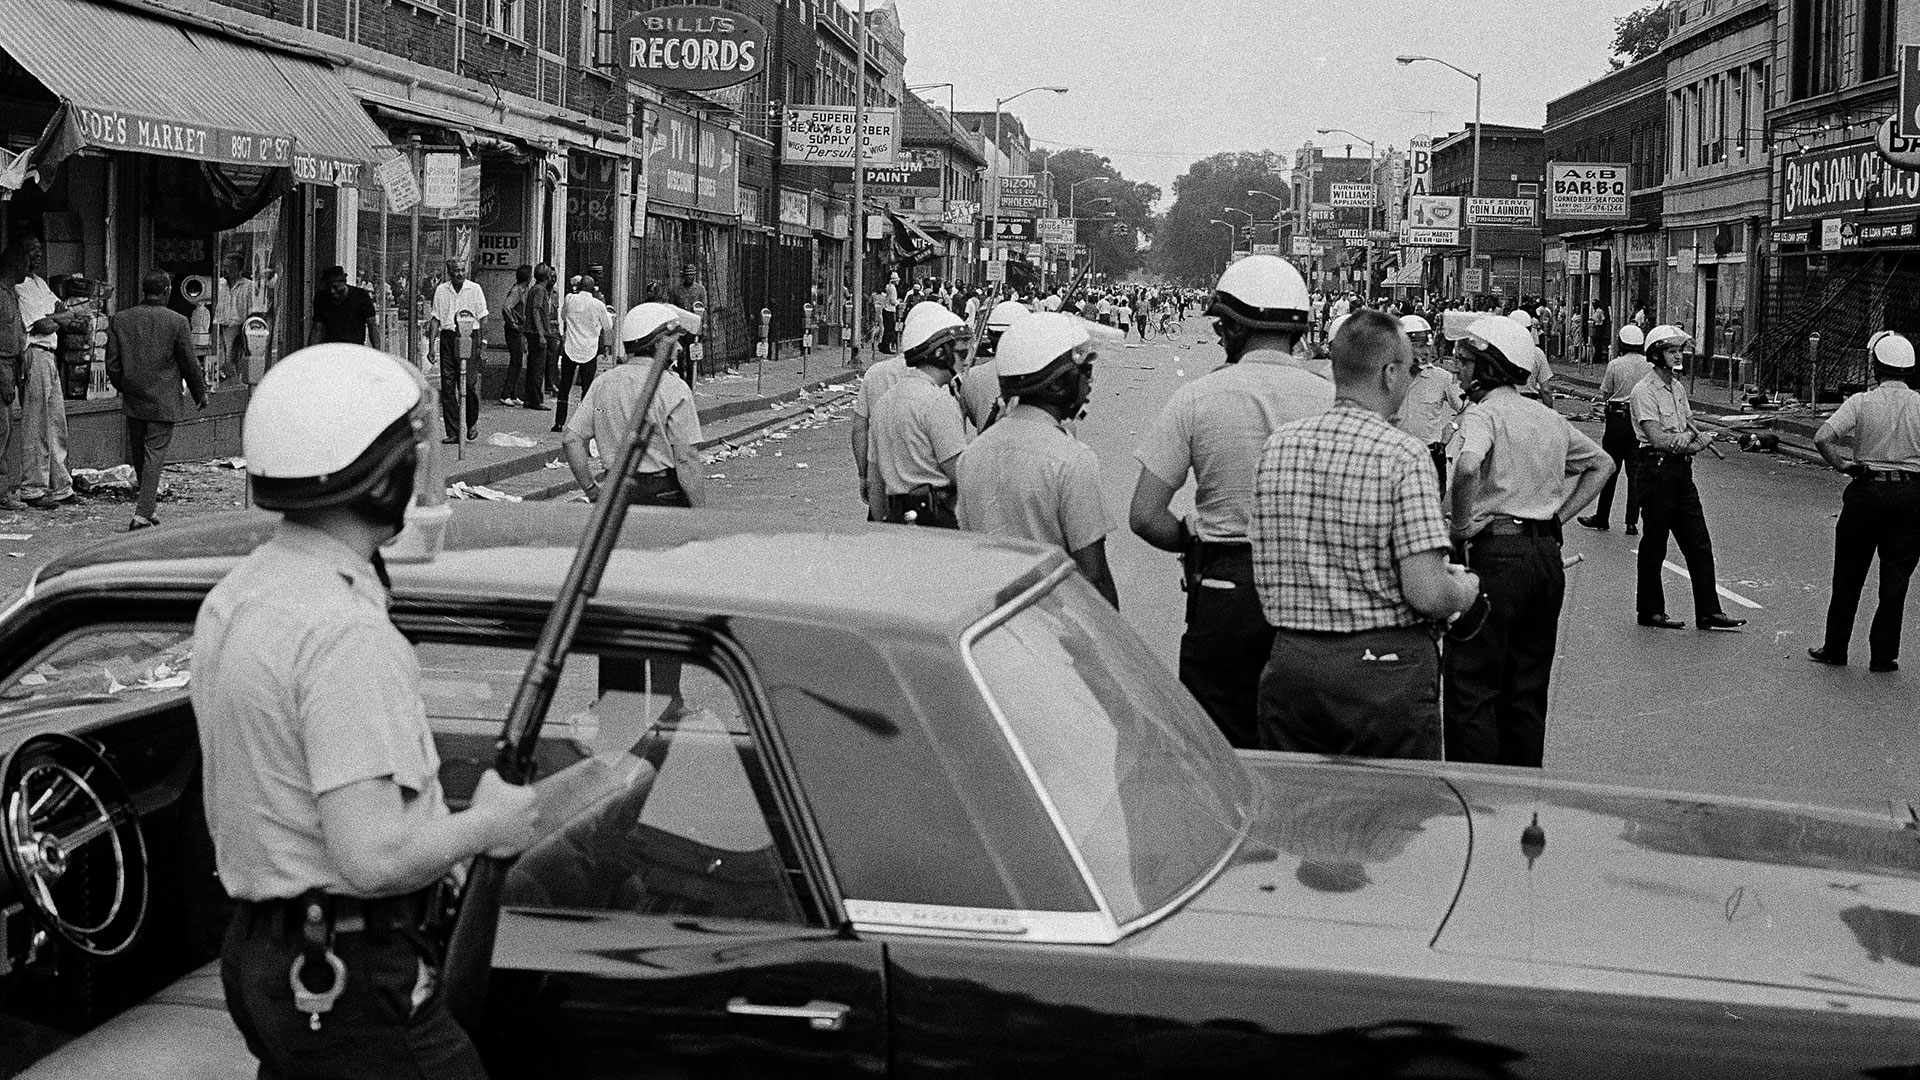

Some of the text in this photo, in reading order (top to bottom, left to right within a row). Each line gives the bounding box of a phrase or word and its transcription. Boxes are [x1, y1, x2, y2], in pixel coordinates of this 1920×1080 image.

[647, 16, 735, 33] BILL'S
[629, 37, 755, 72] RECORDS
[812, 112, 869, 124] SUPERIR
[80, 109, 207, 154] JOE'S MARKET
[809, 134, 850, 145] SUPPLY
[1411, 140, 1432, 148] PARKS
[688, 126, 716, 168] LND
[788, 140, 805, 152] WIGS
[869, 143, 888, 155] WIGS
[293, 153, 316, 180] JOE'S
[867, 171, 911, 183] PAINT
[1563, 170, 1616, 179] A & B
[1822, 155, 1857, 203] LOAN
[1001, 179, 1036, 188] BIZON
[1002, 198, 1048, 208] WHOLESALE
[1469, 205, 1532, 216] COIN LAUNDRY
[1869, 227, 1881, 238] LOAN
[1882, 225, 1898, 237] OFFICE
[480, 236, 519, 249] HIELD
